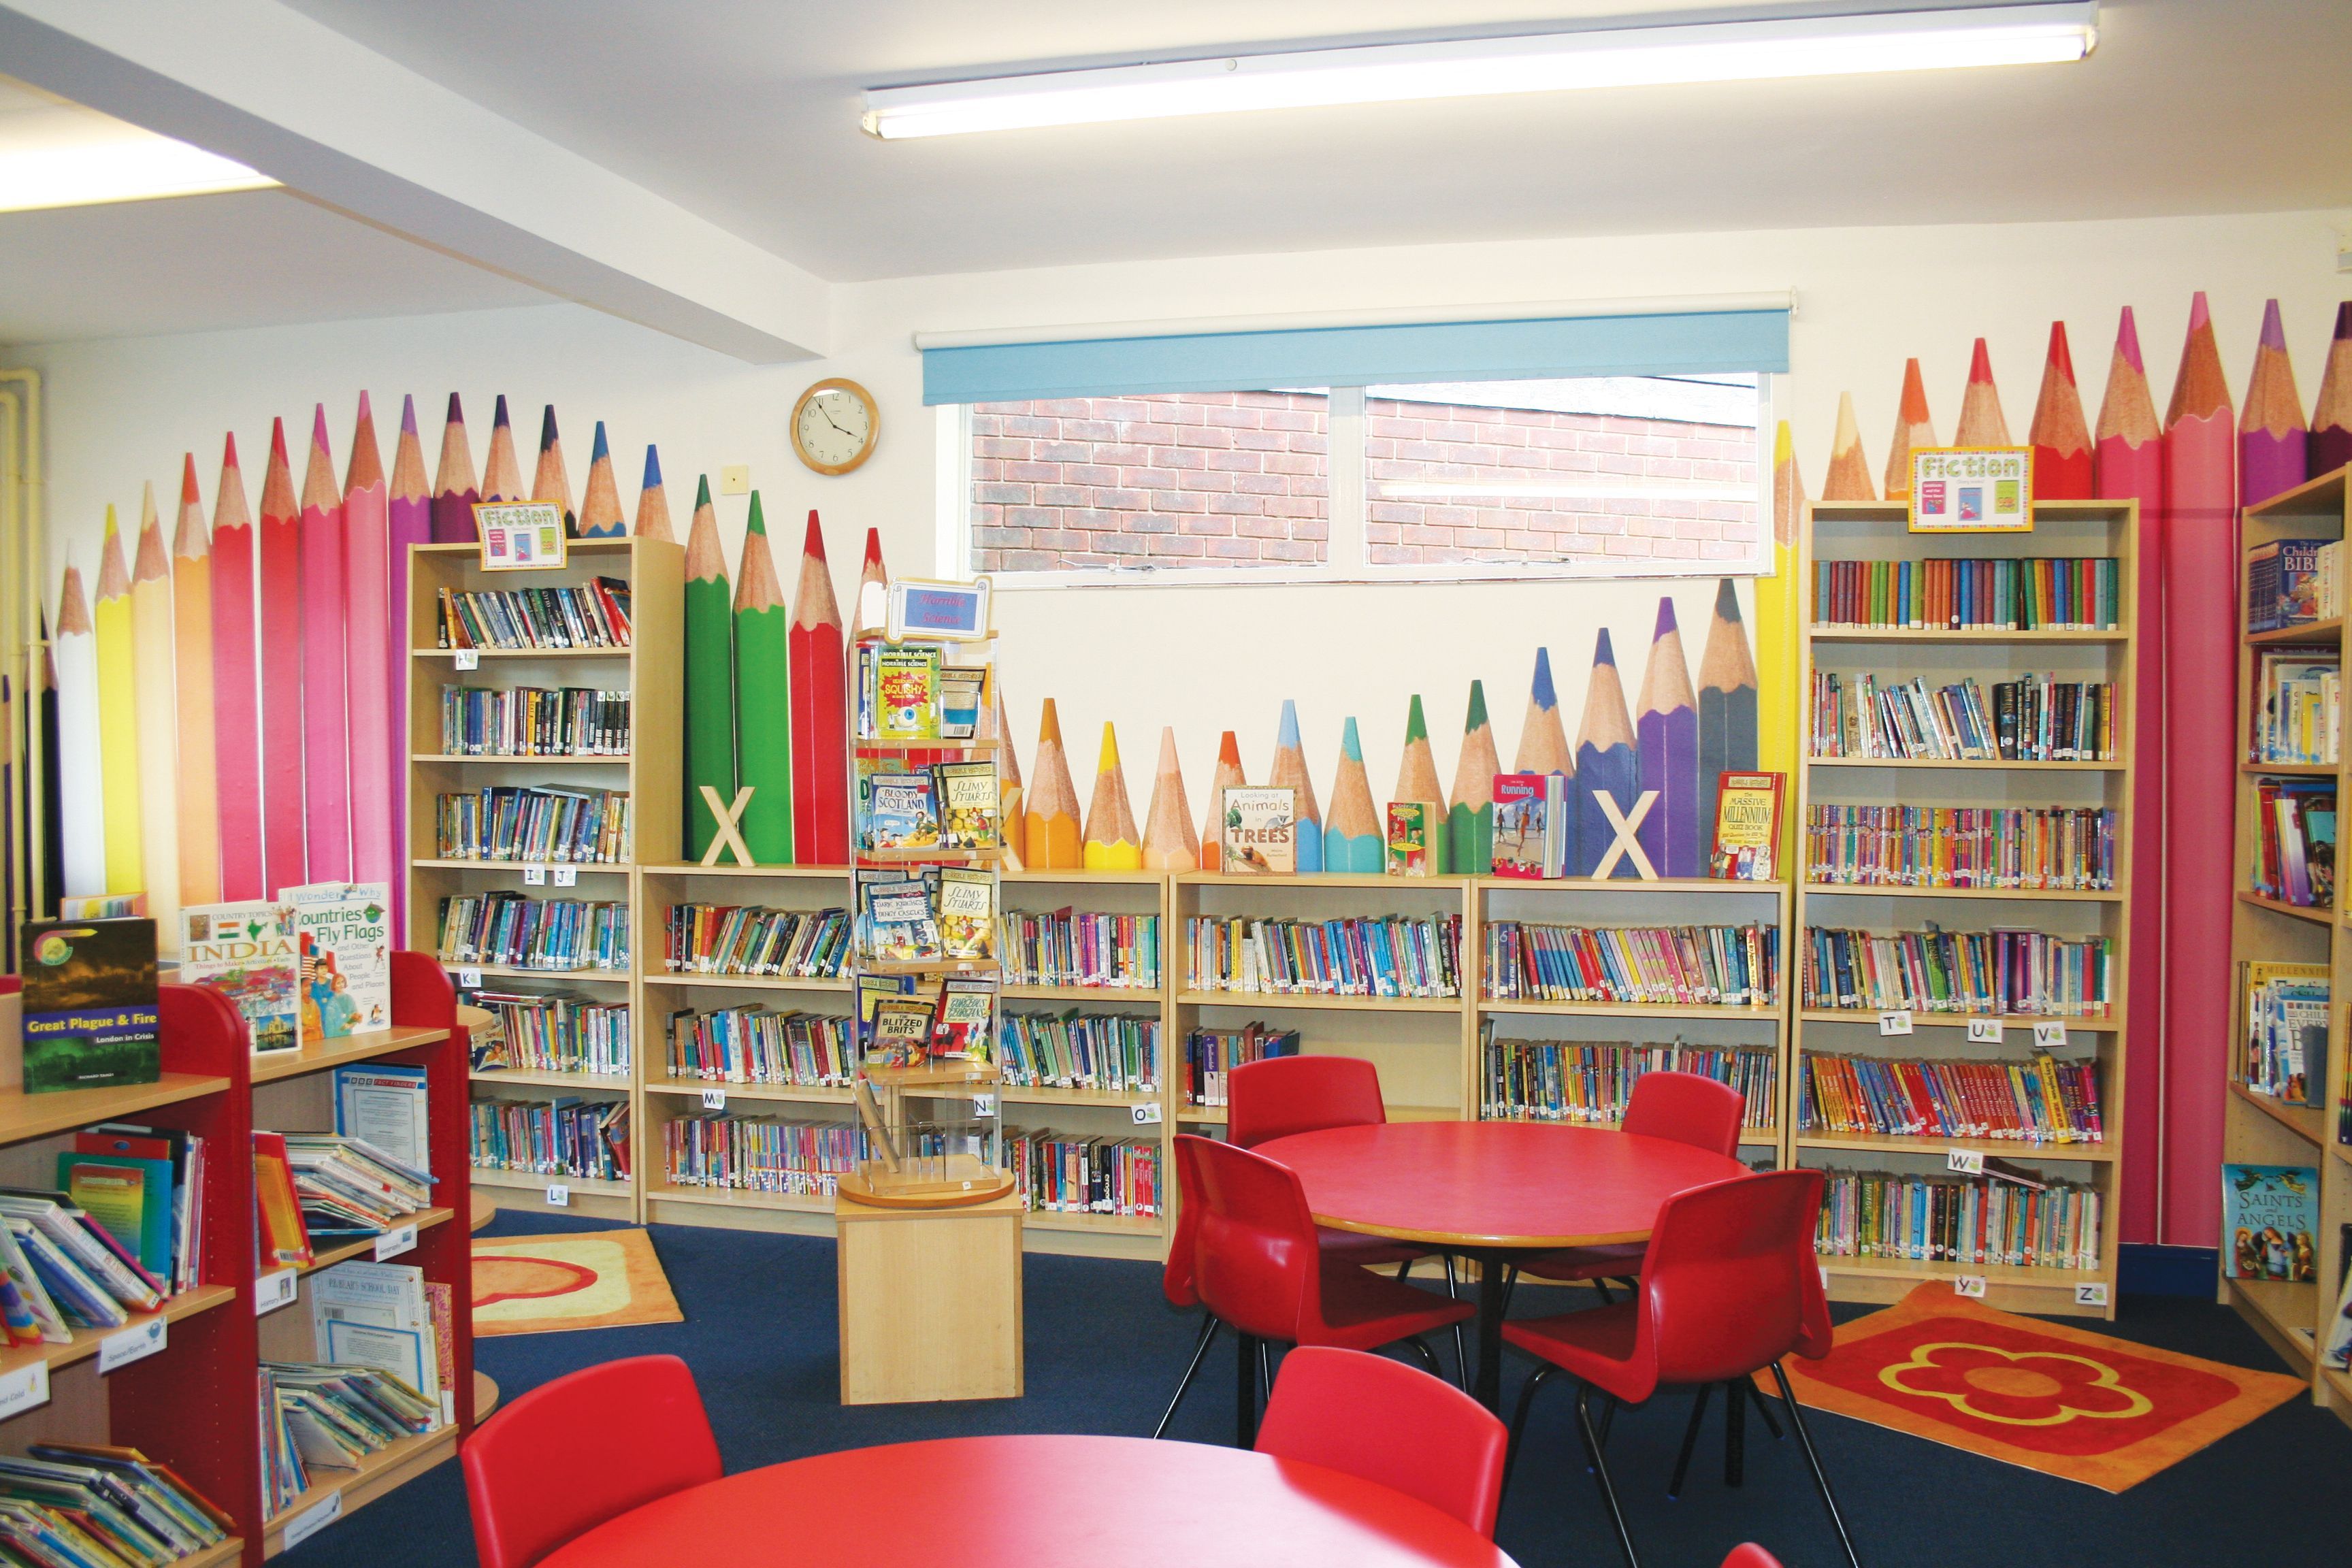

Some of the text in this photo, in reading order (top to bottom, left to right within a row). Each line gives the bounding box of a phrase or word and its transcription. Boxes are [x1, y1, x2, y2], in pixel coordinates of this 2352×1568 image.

[919, 593, 966, 607] Horrible
[921, 612, 961, 624] Science
[885, 684, 924, 695] SQUISHY
[953, 781, 988, 792] SLIMY
[1501, 783, 1535, 797] Running
[883, 789, 919, 799] BLOODY
[952, 791, 992, 802] STUARTS
[877, 798, 925, 810] SCOTLAND
[1230, 799, 1290, 811] Animals
[1730, 797, 1767, 806] MASSIVE
[1722, 806, 1771, 824] MILLENNIUM
[699, 785, 756, 866] X
[1230, 828, 1290, 844] TREES
[1590, 790, 1660, 880] X
[527, 869, 534, 880] I
[557, 871, 565, 883] J
[295, 889, 341, 902] Wonder
[359, 886, 382, 898] Why
[948, 886, 985, 900] SLIMY
[876, 900, 893, 909] DARK
[943, 897, 987, 910] STUARTS
[212, 909, 273, 921] COUNTRY TOPICS
[316, 924, 385, 945] Fly Flags
[186, 938, 296, 963] INDIA
[337, 942, 370, 951] and Other
[339, 952, 372, 962] Questions
[196, 962, 216, 970] Things
[343, 963, 363, 971] About
[349, 972, 371, 981] People
[463, 973, 470, 984] K
[365, 980, 385, 988] Places
[951, 998, 987, 1008] GORGEOUS
[947, 1007, 987, 1017] GEORGIANS
[27, 1013, 157, 1033] Great Plague & Fire
[882, 1018, 923, 1028] BLITZED
[1883, 1017, 1895, 1030] T
[887, 1026, 915, 1034] BRITS
[1972, 1024, 1984, 1038] U
[2038, 1028, 2048, 1041] V
[96, 1035, 124, 1043] London
[134, 1032, 154, 1041] Crisis
[704, 1093, 716, 1105] M
[975, 1100, 987, 1112] N
[1134, 1109, 1146, 1120] O
[1950, 1153, 1970, 1169] W
[550, 1188, 557, 1201] L
[2239, 1191, 2303, 1209] SAINTS
[2237, 1212, 2306, 1230] ANGELS
[378, 1242, 402, 1256] Geography
[387, 1285, 401, 1296] DAY
[2079, 1287, 2093, 1300] Z
[260, 1297, 280, 1309] History
